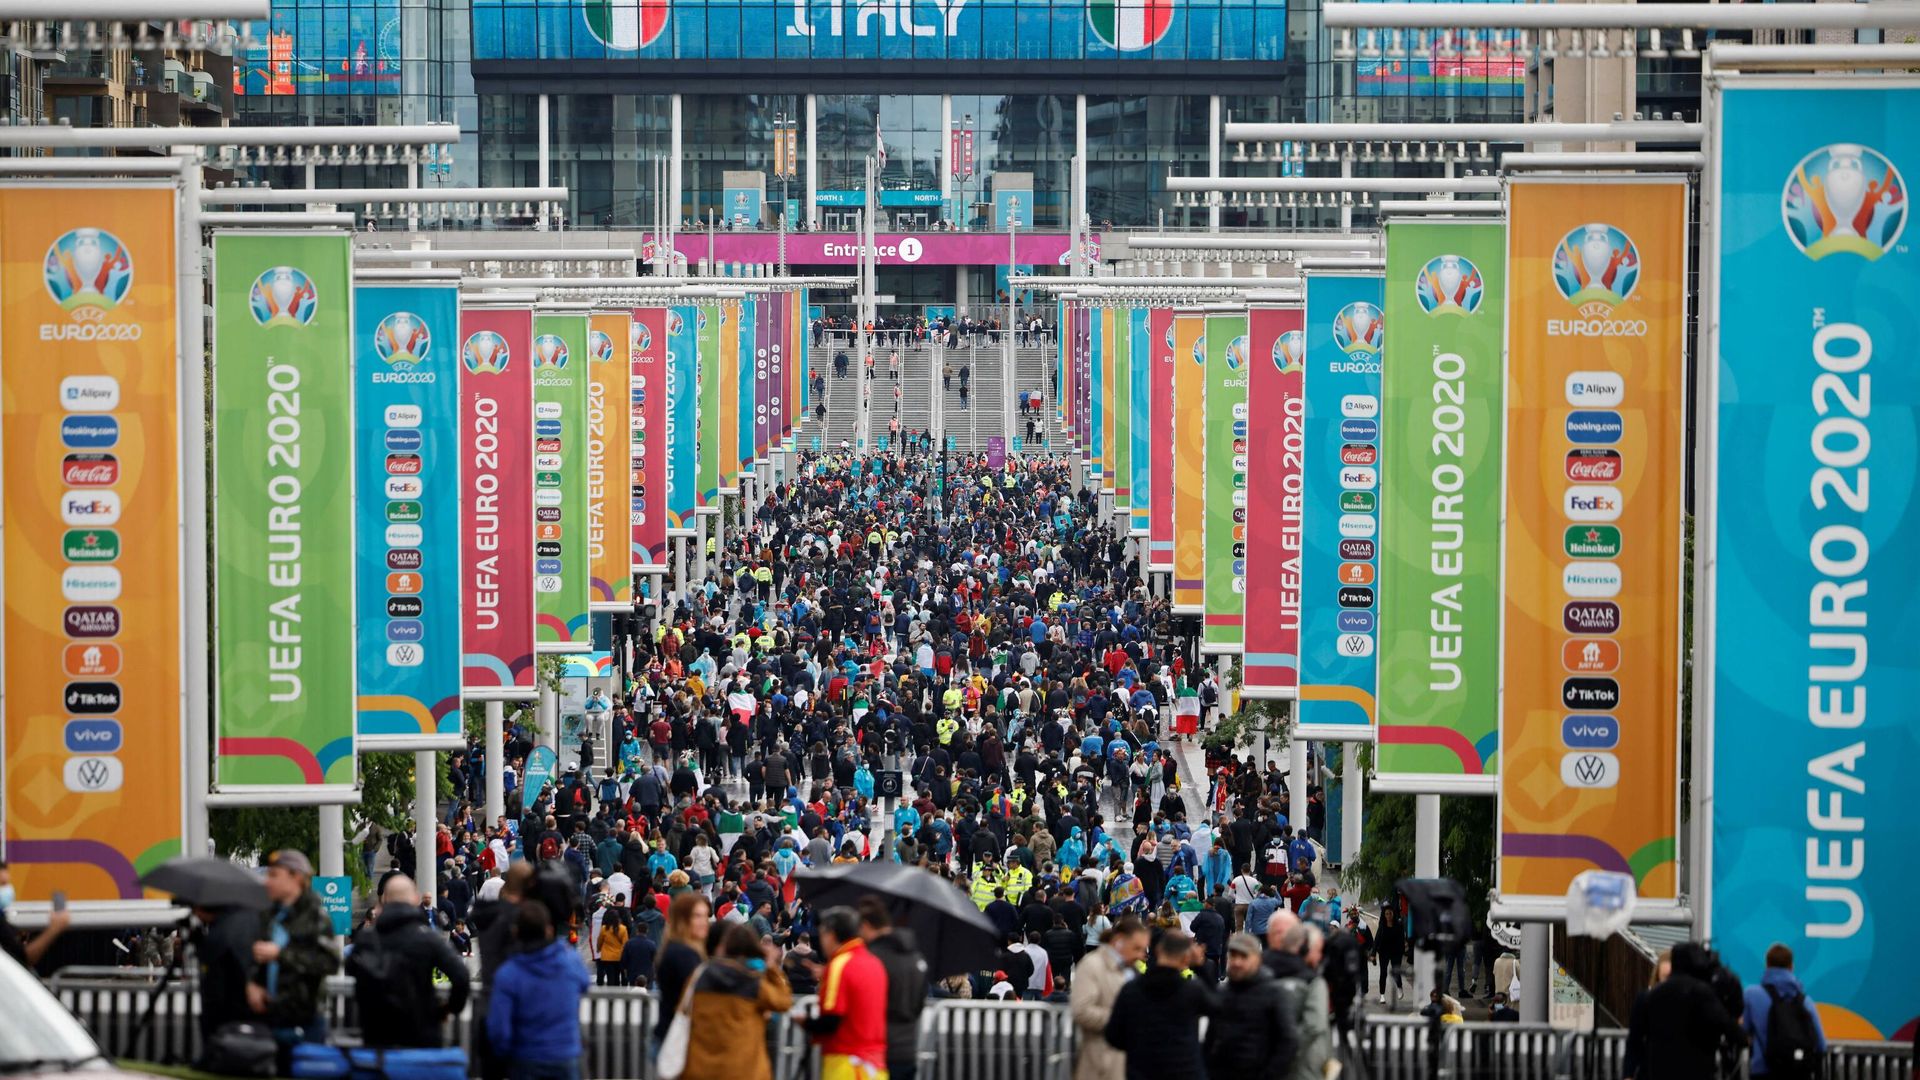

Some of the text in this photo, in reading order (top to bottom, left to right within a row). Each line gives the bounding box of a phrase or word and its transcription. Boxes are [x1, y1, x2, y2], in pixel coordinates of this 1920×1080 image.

[1578, 302, 1614, 320] UEFA
[1547, 320, 1647, 337] EURO2020
[1350, 352, 1372, 362] UEFA
[81, 388, 112, 399] Alipay
[1586, 384, 1616, 396] Alipay
[63, 426, 117, 436] Booking.com
[1568, 421, 1620, 433] Booking.com
[590, 382, 604, 559] UEFA EURO 2020
[1344, 474, 1372, 482] FedEx
[390, 484, 416, 492] FedEx
[69, 501, 111, 514] FedEx
[1572, 496, 1614, 510] FedEx
[476, 474, 498, 550] EURO
[1282, 474, 1302, 550] EURO
[1432, 464, 1464, 576] EURO
[268, 475, 301, 586] EURO
[68, 548, 114, 558] Heineken
[1342, 544, 1370, 553] QATAR
[1570, 543, 1615, 554] Heineken
[390, 553, 418, 562] QATAR
[66, 580, 116, 588] Hisense
[1567, 575, 1618, 585] Hisense
[476, 556, 499, 630] UEFA
[1281, 556, 1300, 630] UEFA
[68, 612, 114, 627] QATAR
[1568, 608, 1614, 622] QATAR
[1808, 525, 1870, 728] EURO
[1430, 583, 1463, 691] UEFA
[269, 594, 302, 702] UEFA
[81, 693, 116, 704] TikTok
[1579, 689, 1614, 701] TikTok
[74, 729, 112, 742] vivo
[1573, 725, 1609, 738] vivo
[1806, 741, 1866, 938] UEFA
[330, 905, 349, 913] Shop
